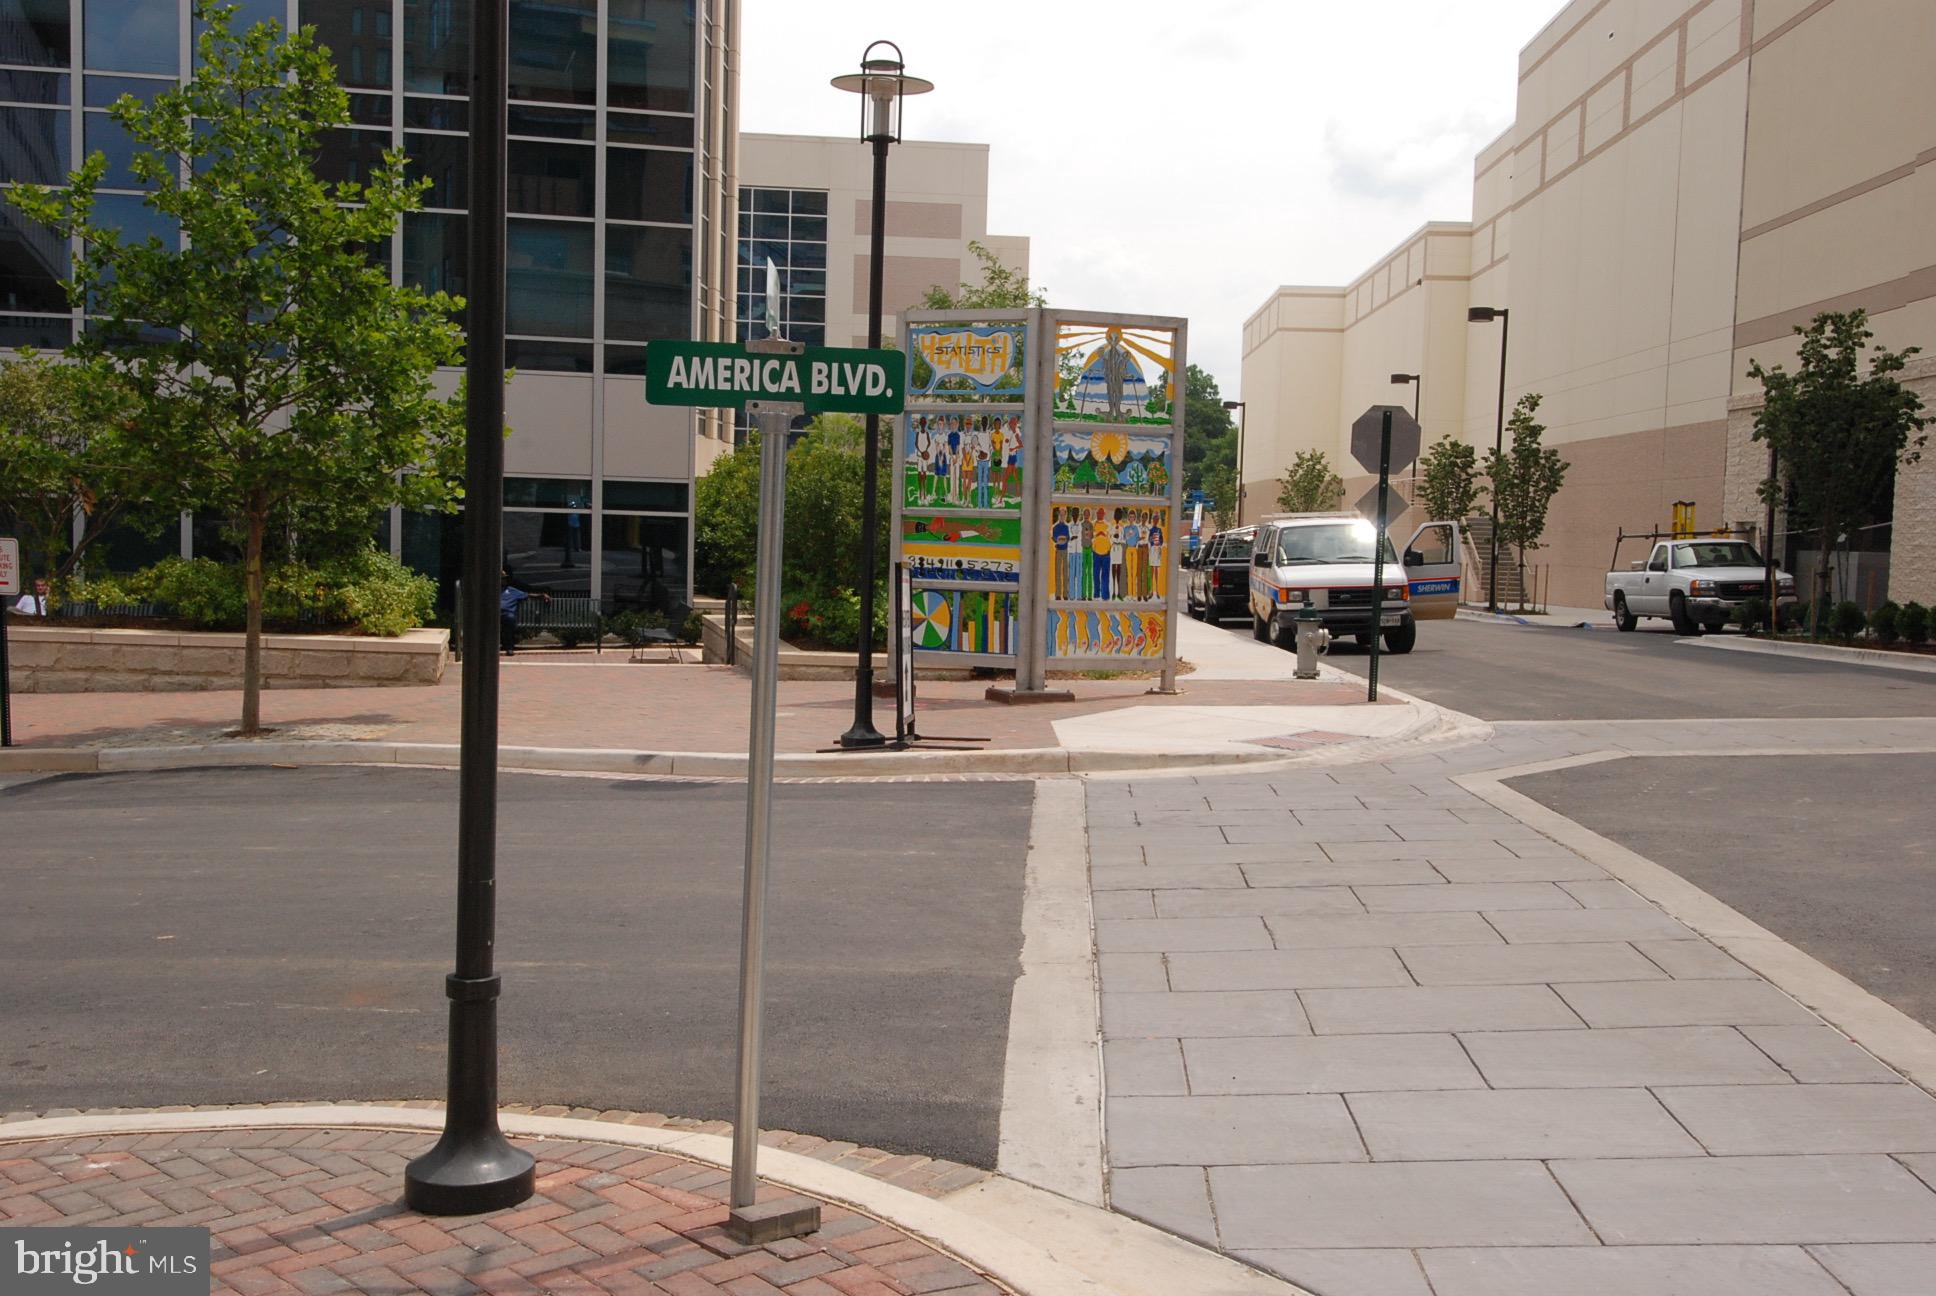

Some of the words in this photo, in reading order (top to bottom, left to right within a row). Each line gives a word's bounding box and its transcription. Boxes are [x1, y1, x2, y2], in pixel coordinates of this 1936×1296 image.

[921, 332, 1008, 375] HEALTH
[935, 345, 1002, 357] STATISTICS
[667, 355, 801, 393] AMERICA
[811, 361, 894, 398] BLVD.
